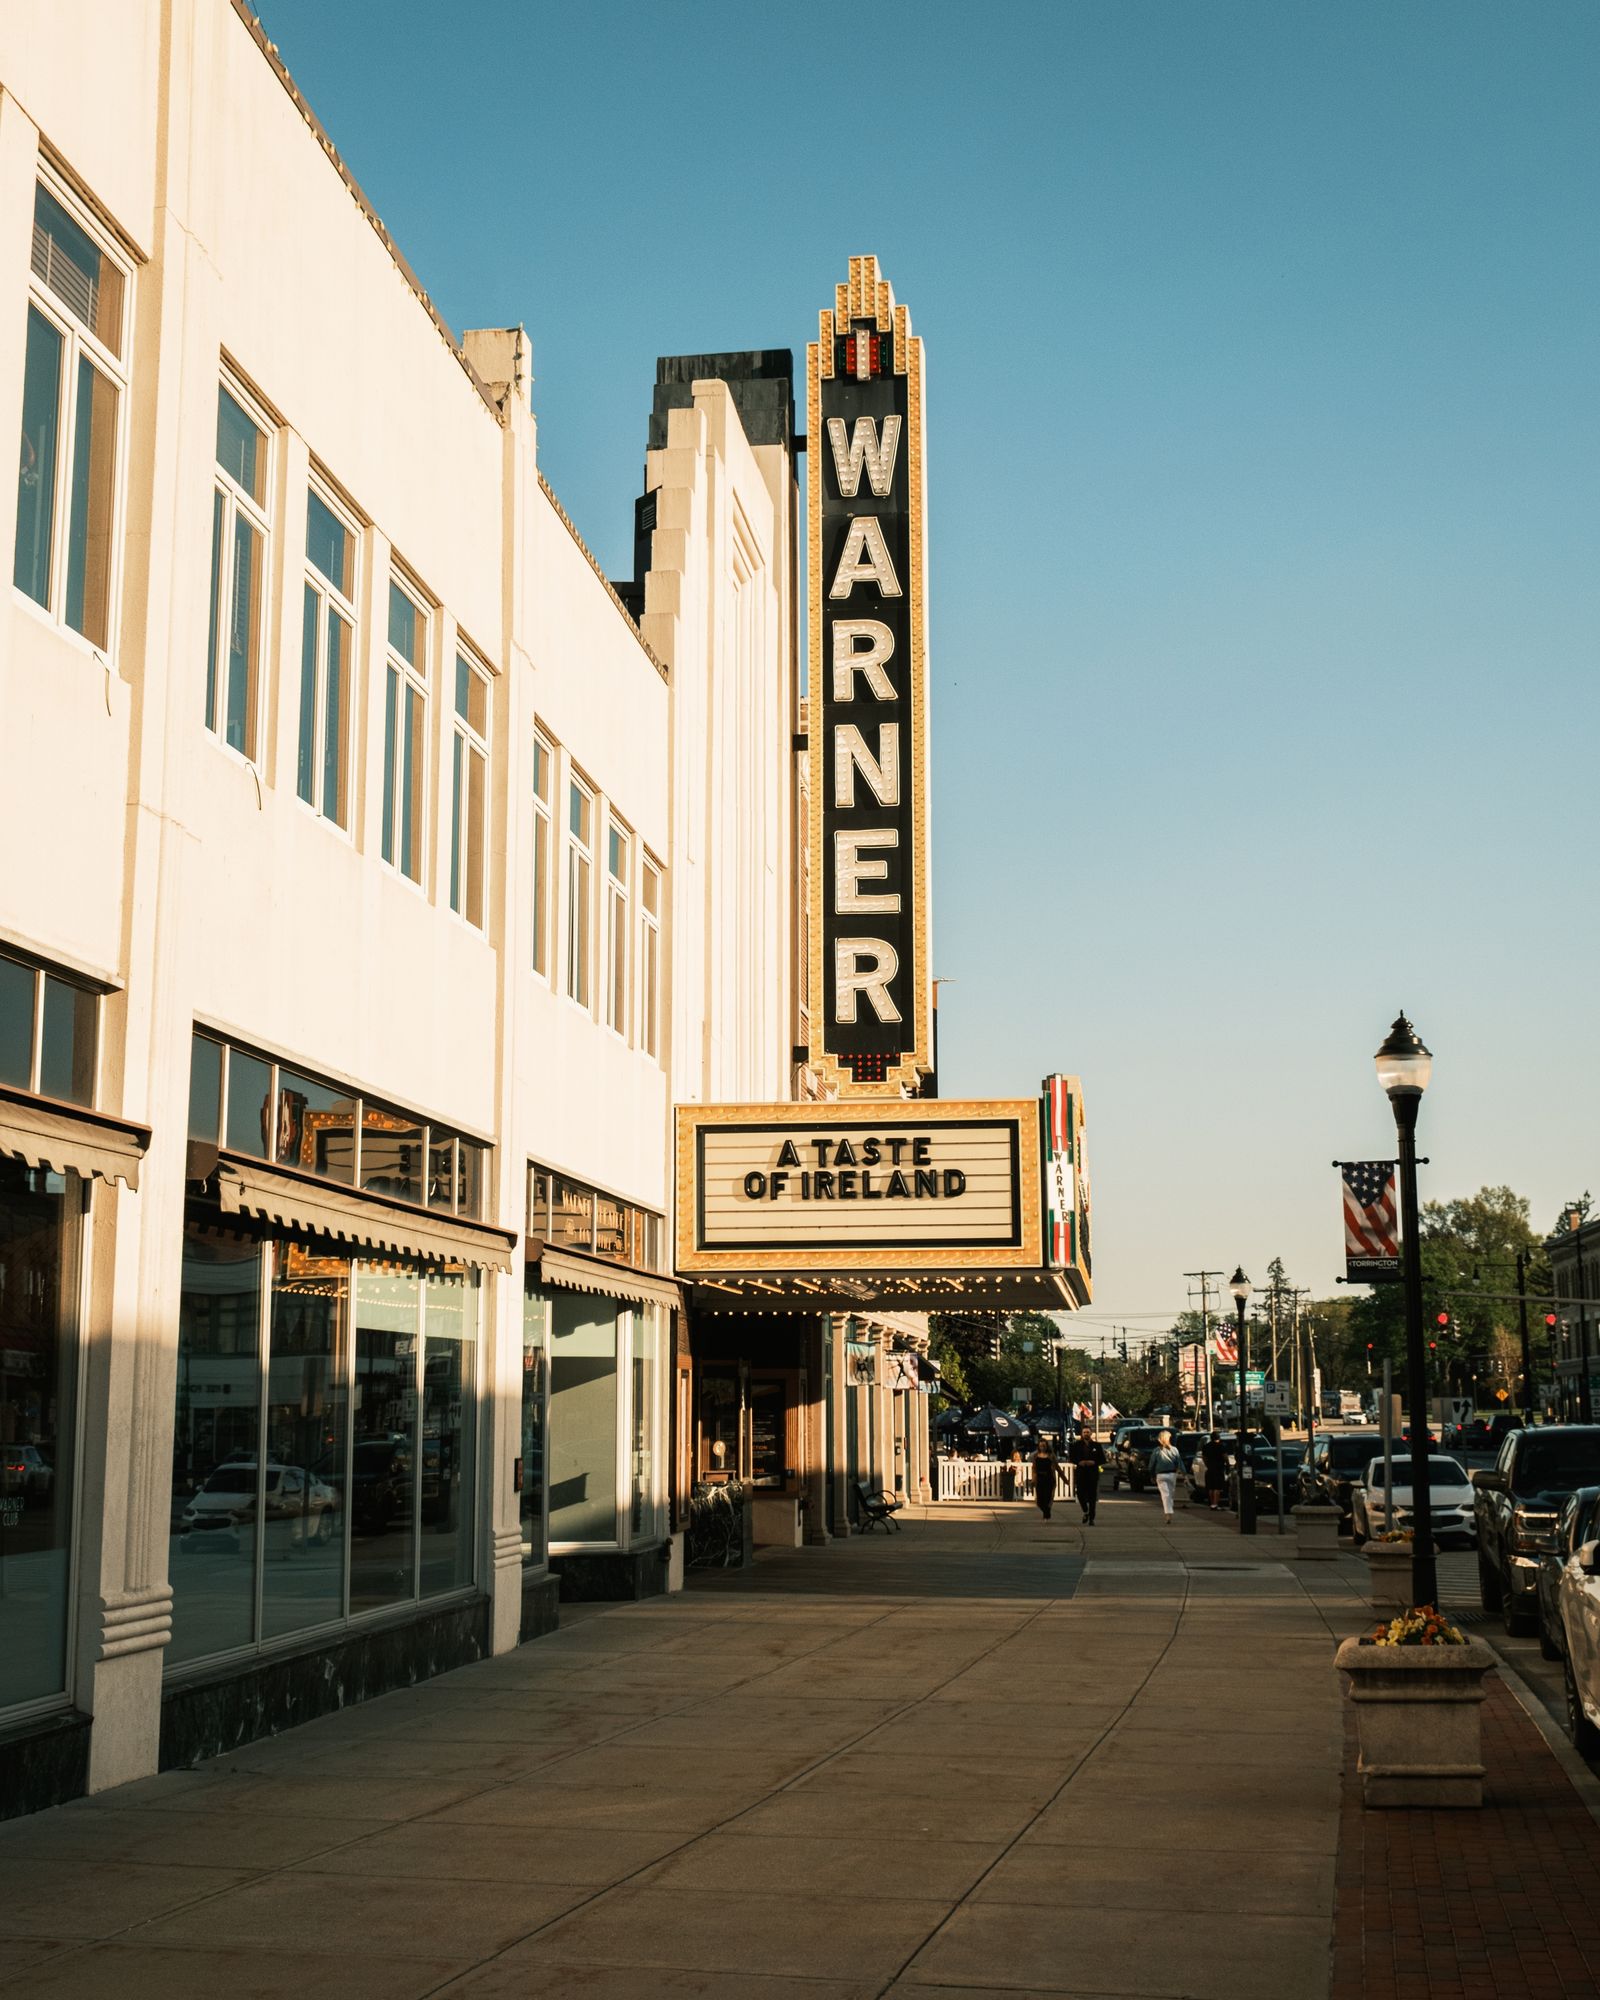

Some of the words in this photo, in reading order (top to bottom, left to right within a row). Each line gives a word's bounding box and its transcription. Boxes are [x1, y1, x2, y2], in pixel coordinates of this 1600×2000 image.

[827, 415, 904, 1024] WARNER
[776, 1139, 800, 1168] A
[811, 1137, 932, 1168] TASTE
[743, 1170, 789, 1200] OF
[801, 1168, 967, 1200] IRELAND
[1053, 1152, 1069, 1222] WARNER
[1351, 1259, 1399, 1267] TORRINGTON
